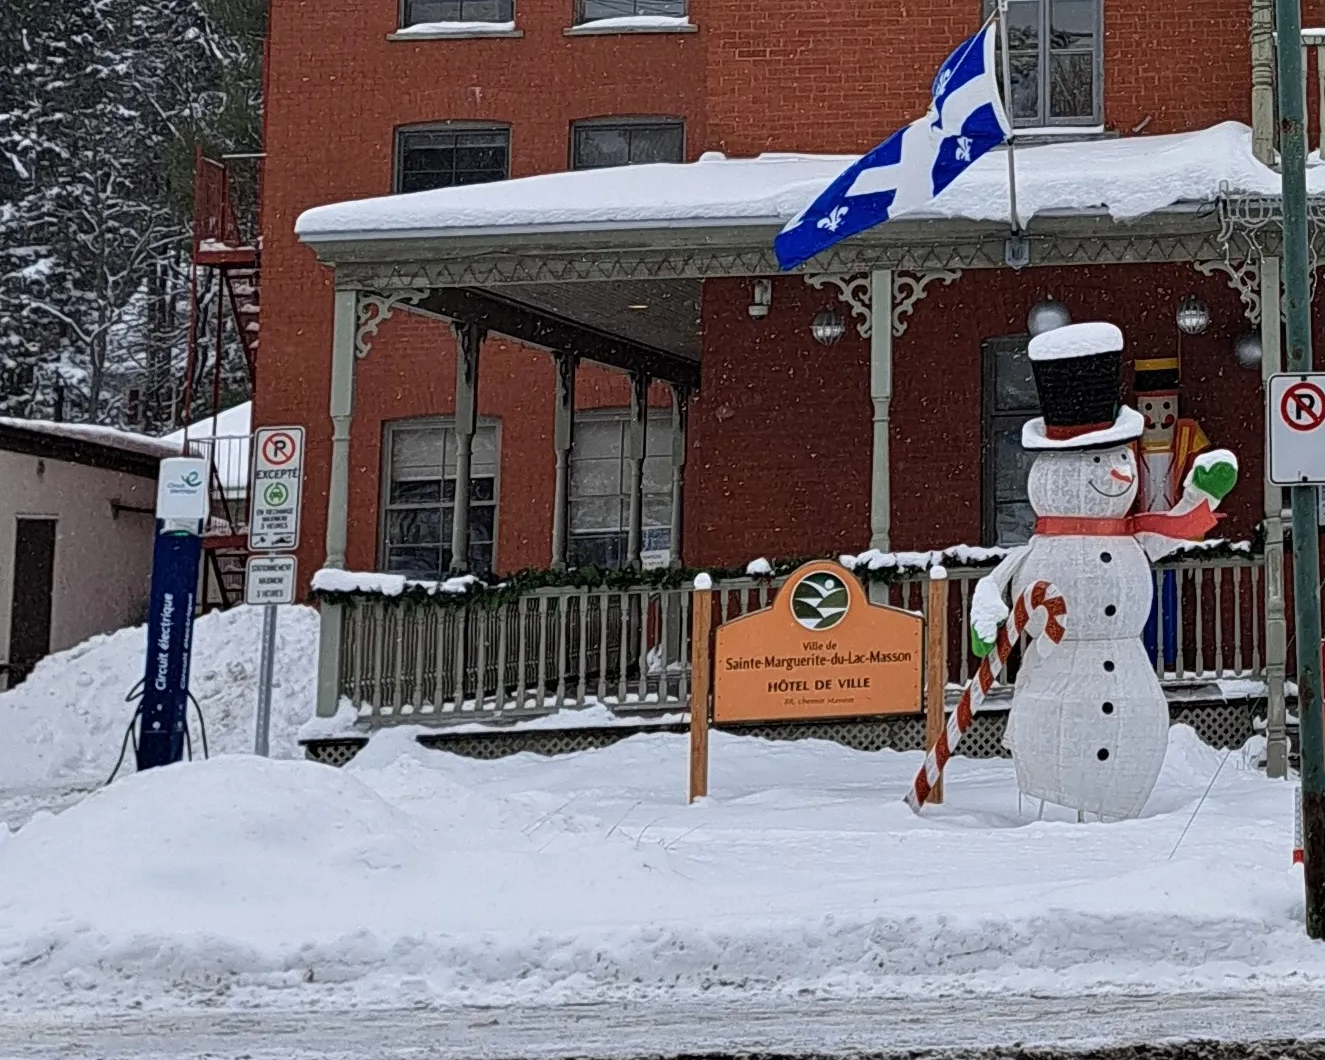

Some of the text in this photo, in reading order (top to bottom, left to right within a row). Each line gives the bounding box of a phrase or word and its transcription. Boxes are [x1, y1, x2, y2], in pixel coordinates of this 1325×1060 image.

[256, 467, 299, 480] EXCEPTÉ
[155, 592, 175, 690] Circuit électrique
[803, 641, 837, 652] Ville de
[725, 650, 912, 671] Sainte-Marguerite-du-Lac-Masson
[767, 678, 870, 692] HÔTEL DE VILLE
